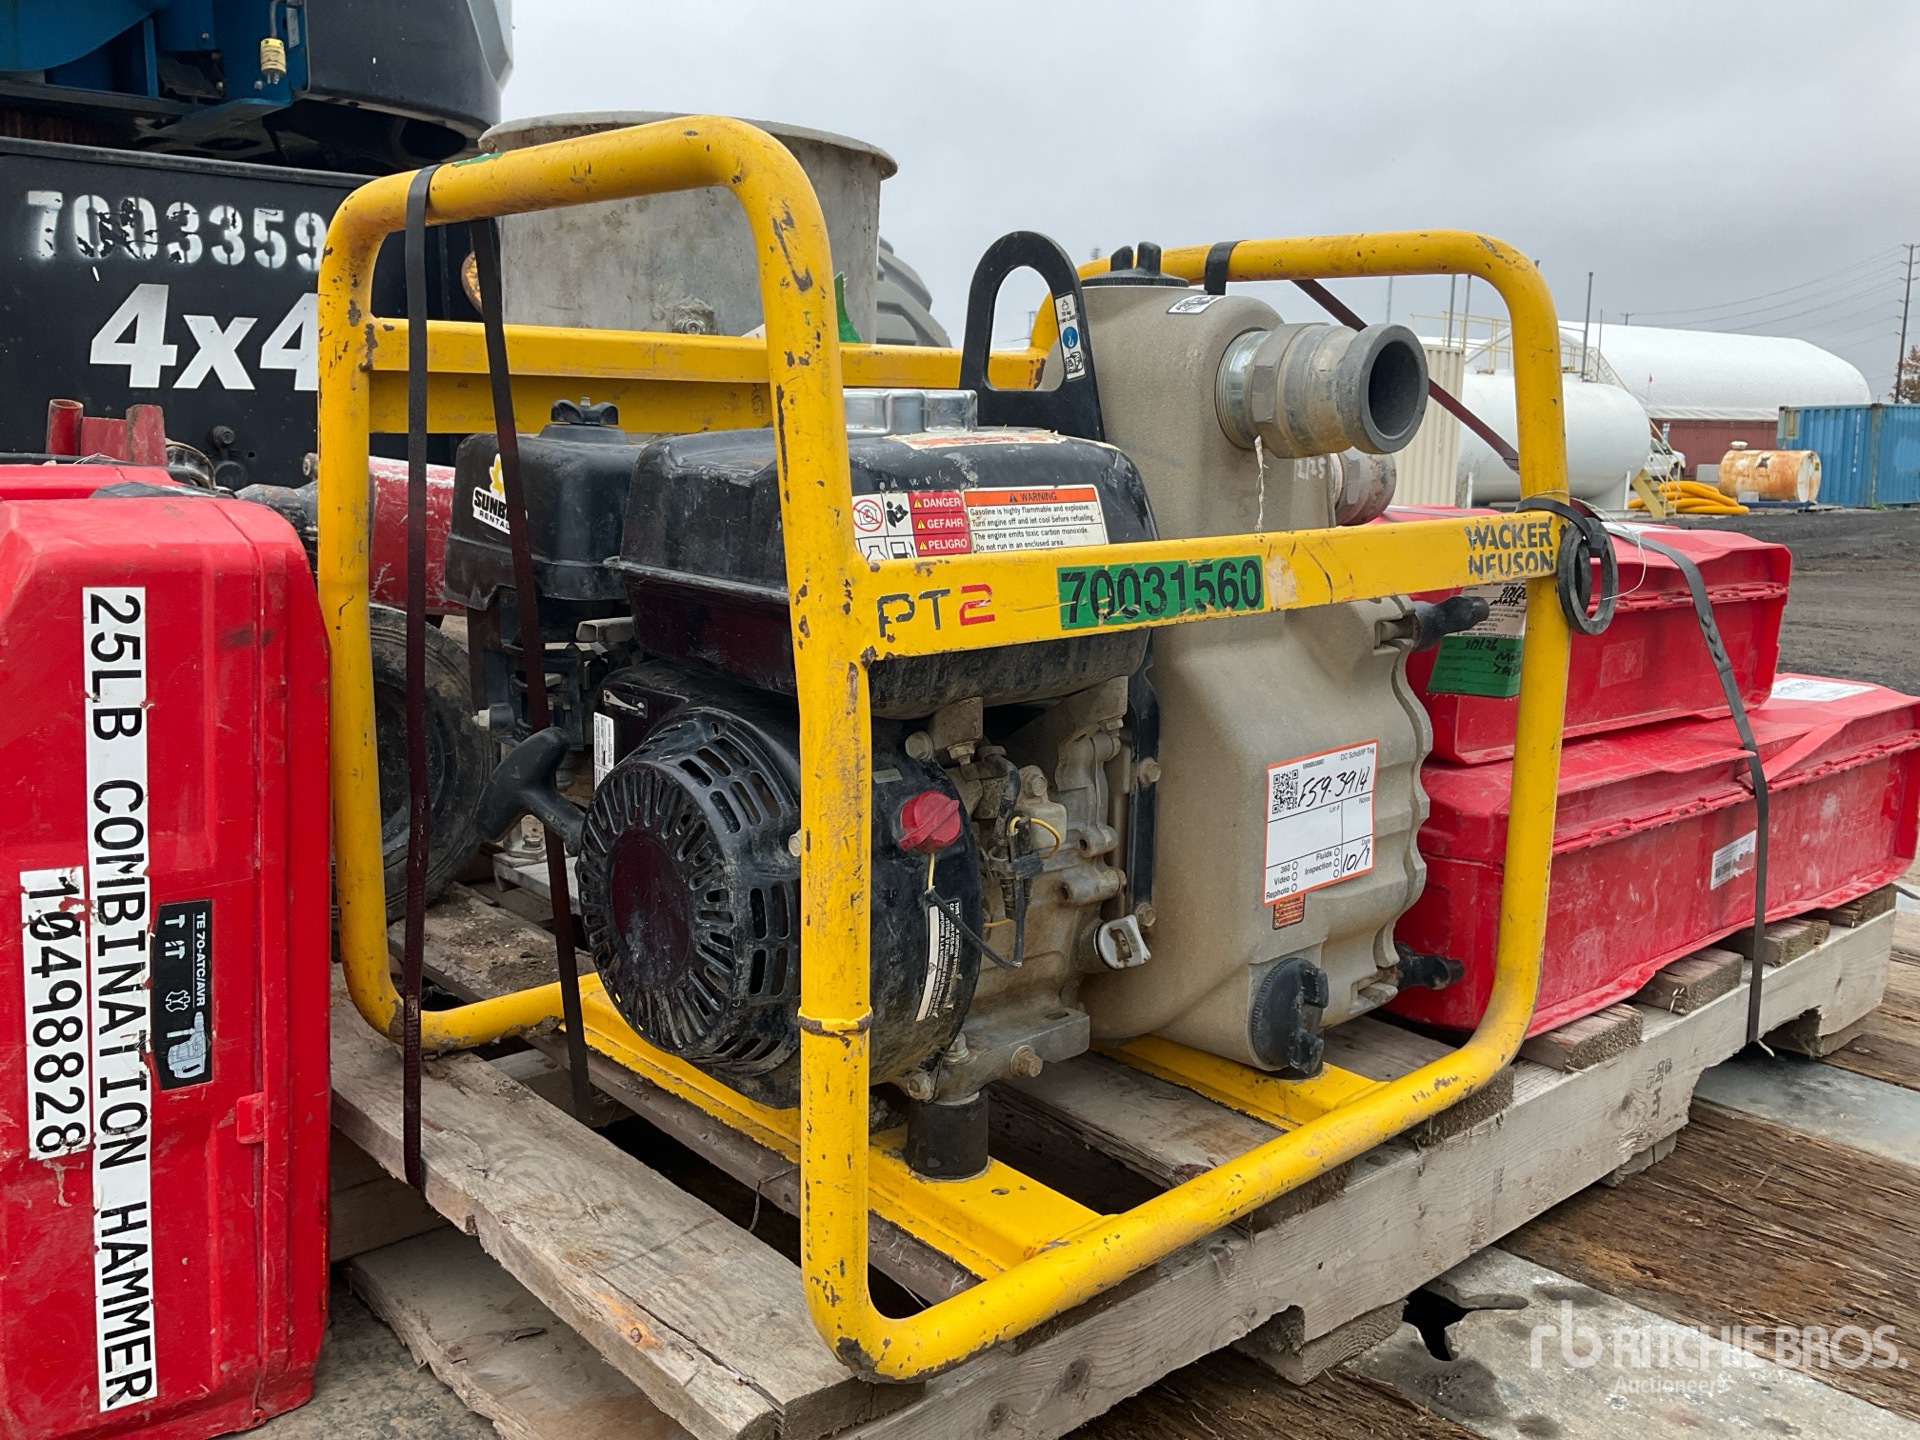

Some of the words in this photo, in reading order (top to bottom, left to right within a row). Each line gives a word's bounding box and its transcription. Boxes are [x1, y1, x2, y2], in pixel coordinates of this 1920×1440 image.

[90, 283, 318, 391] 4x4
[923, 497, 961, 508] DANGER
[1020, 492, 1057, 501] WARNING
[474, 490, 507, 519] SUNB
[970, 508, 995, 516] Gasoline
[997, 507, 1002, 515] is
[1003, 506, 1020, 516] highly
[1022, 505, 1051, 514] flammable
[1064, 504, 1090, 513] explosive.
[480, 511, 510, 530] RENTAL
[927, 518, 964, 529] GEFAHR
[972, 519, 986, 527] Turn
[987, 519, 1007, 528] engine
[1008, 517, 1016, 525] off
[1029, 516, 1037, 524] let
[1052, 515, 1069, 523] before
[1071, 514, 1095, 523] refueling.
[974, 532, 985, 540] The
[987, 532, 1007, 540] engine
[1026, 529, 1039, 537] toxic
[1041, 528, 1060, 536] carbon
[1062, 527, 1089, 535] monoxide.
[1464, 521, 1553, 551] WACKER
[928, 538, 968, 550] PELIGRO
[976, 543, 985, 552] Do
[1009, 541, 1014, 549] in
[1024, 540, 1050, 548] enclosed
[1468, 550, 1554, 580] NEUSON
[1060, 560, 1262, 624] 70031560
[90, 594, 142, 740] 25LB
[1340, 753, 1348, 761] OC
[1315, 850, 1333, 861] Fluids
[1280, 864, 1291, 874] 360
[1304, 861, 1333, 876] Inspection
[1273, 876, 1290, 886] Video
[1266, 887, 1290, 900] Rephoto
[196, 912, 206, 929] TE
[93, 779, 148, 1169] COMBINATION
[196, 932, 206, 1007] 70-ATC/AVR
[29, 876, 86, 1153] 10498828
[100, 1201, 153, 1408] HAMMER
